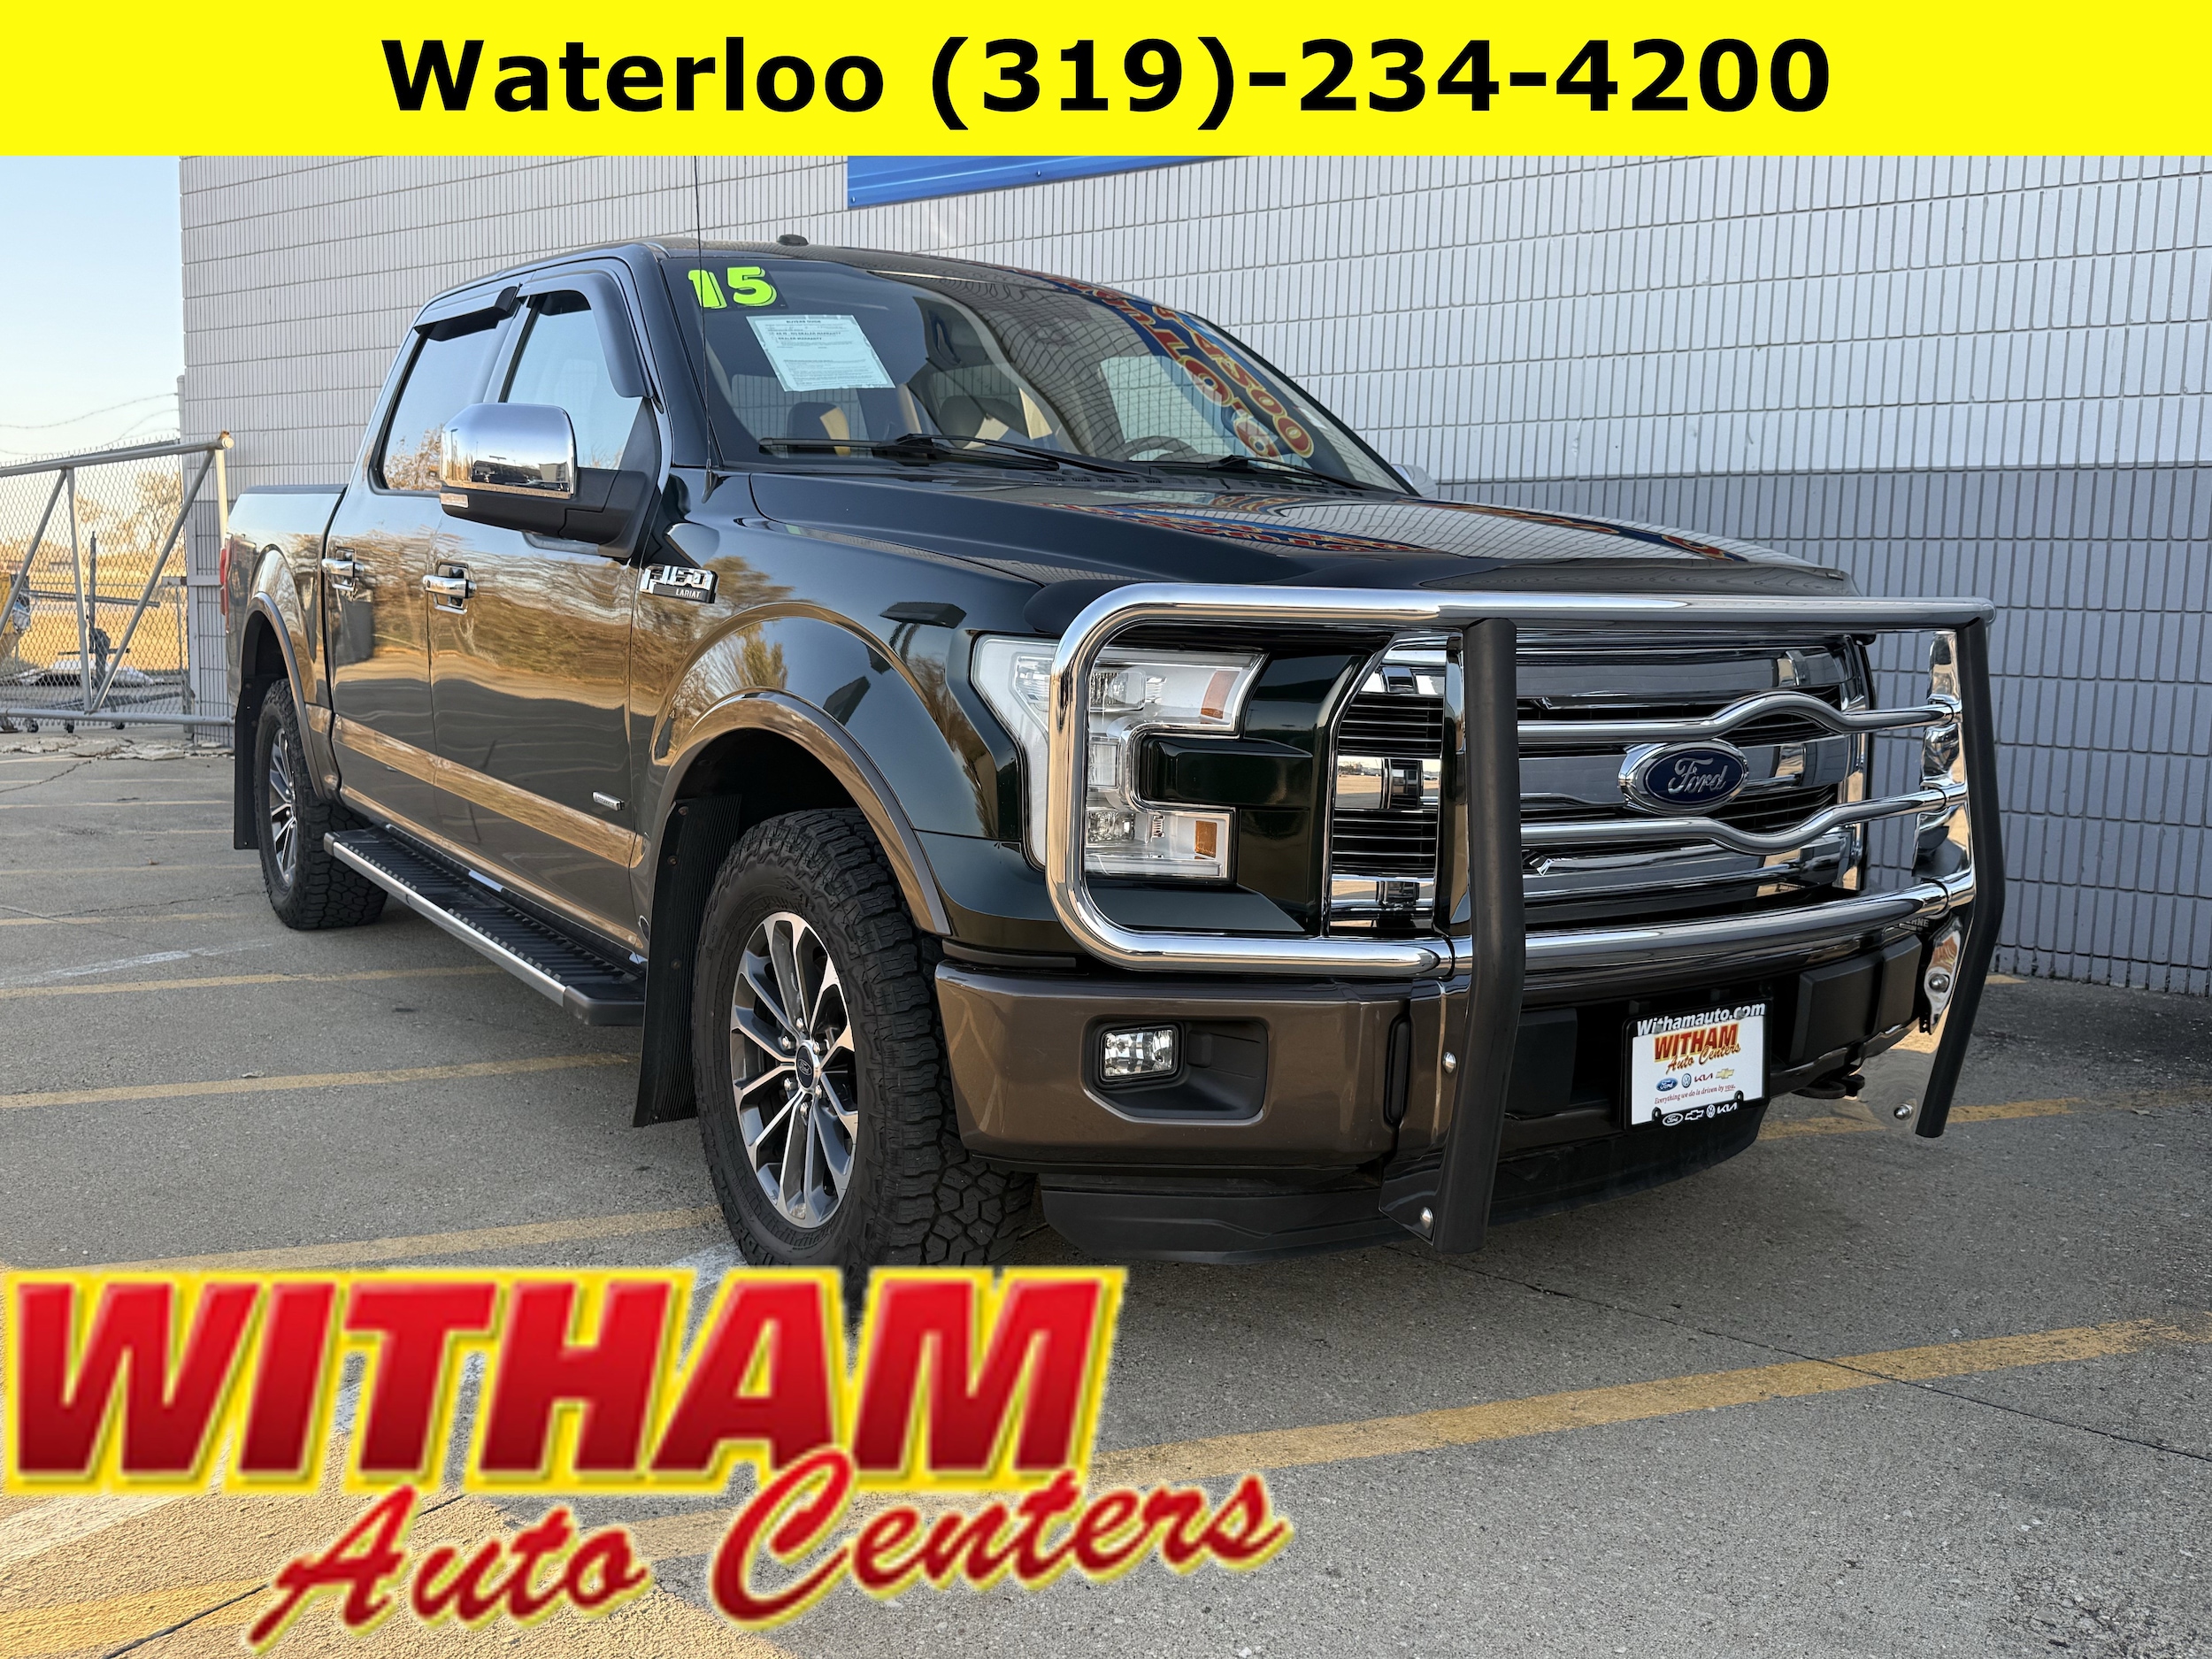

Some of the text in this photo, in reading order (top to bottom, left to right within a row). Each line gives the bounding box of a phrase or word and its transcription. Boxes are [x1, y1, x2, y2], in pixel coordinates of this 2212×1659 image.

[687, 265, 777, 309] 15
[676, 588, 701, 599] LARIAT
[1668, 758, 1728, 795] Ford
[1637, 1002, 1766, 1037] Withamauto.com
[1654, 1023, 1740, 1061] WITHAM
[1665, 1042, 1741, 1075] Auto Centers
[1655, 1093, 1681, 1104] Everything
[1701, 1086, 1717, 1095] driven
[1718, 1084, 1724, 1093] by
